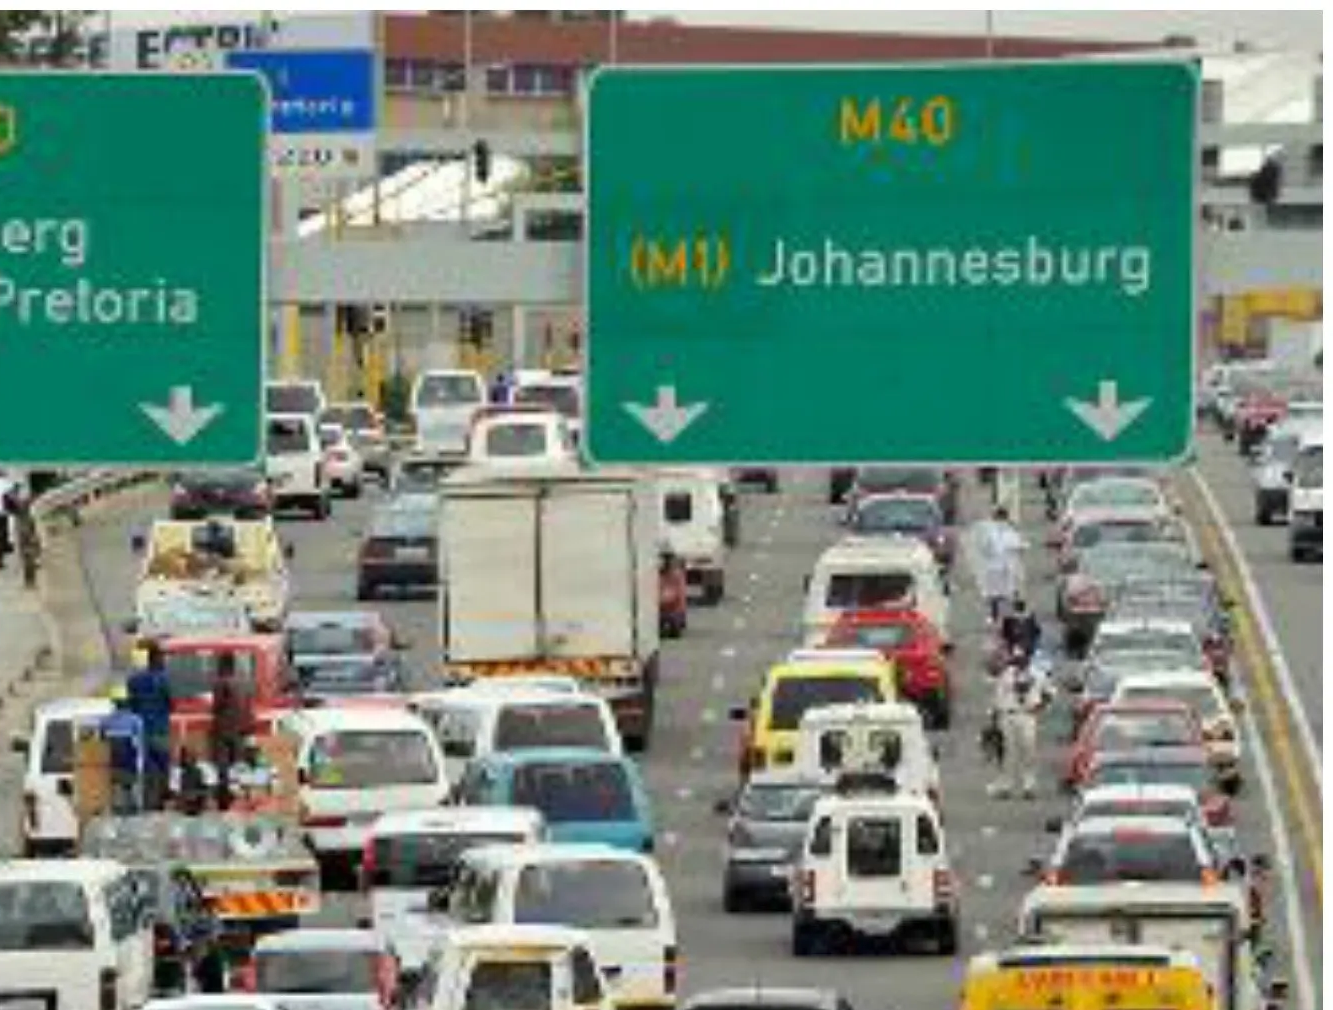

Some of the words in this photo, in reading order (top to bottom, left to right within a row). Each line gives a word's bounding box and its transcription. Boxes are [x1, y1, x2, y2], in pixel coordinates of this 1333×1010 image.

[838, 97, 958, 145] M40
[630, 237, 730, 290] (M1)
[757, 236, 1152, 294] Johannesburg
